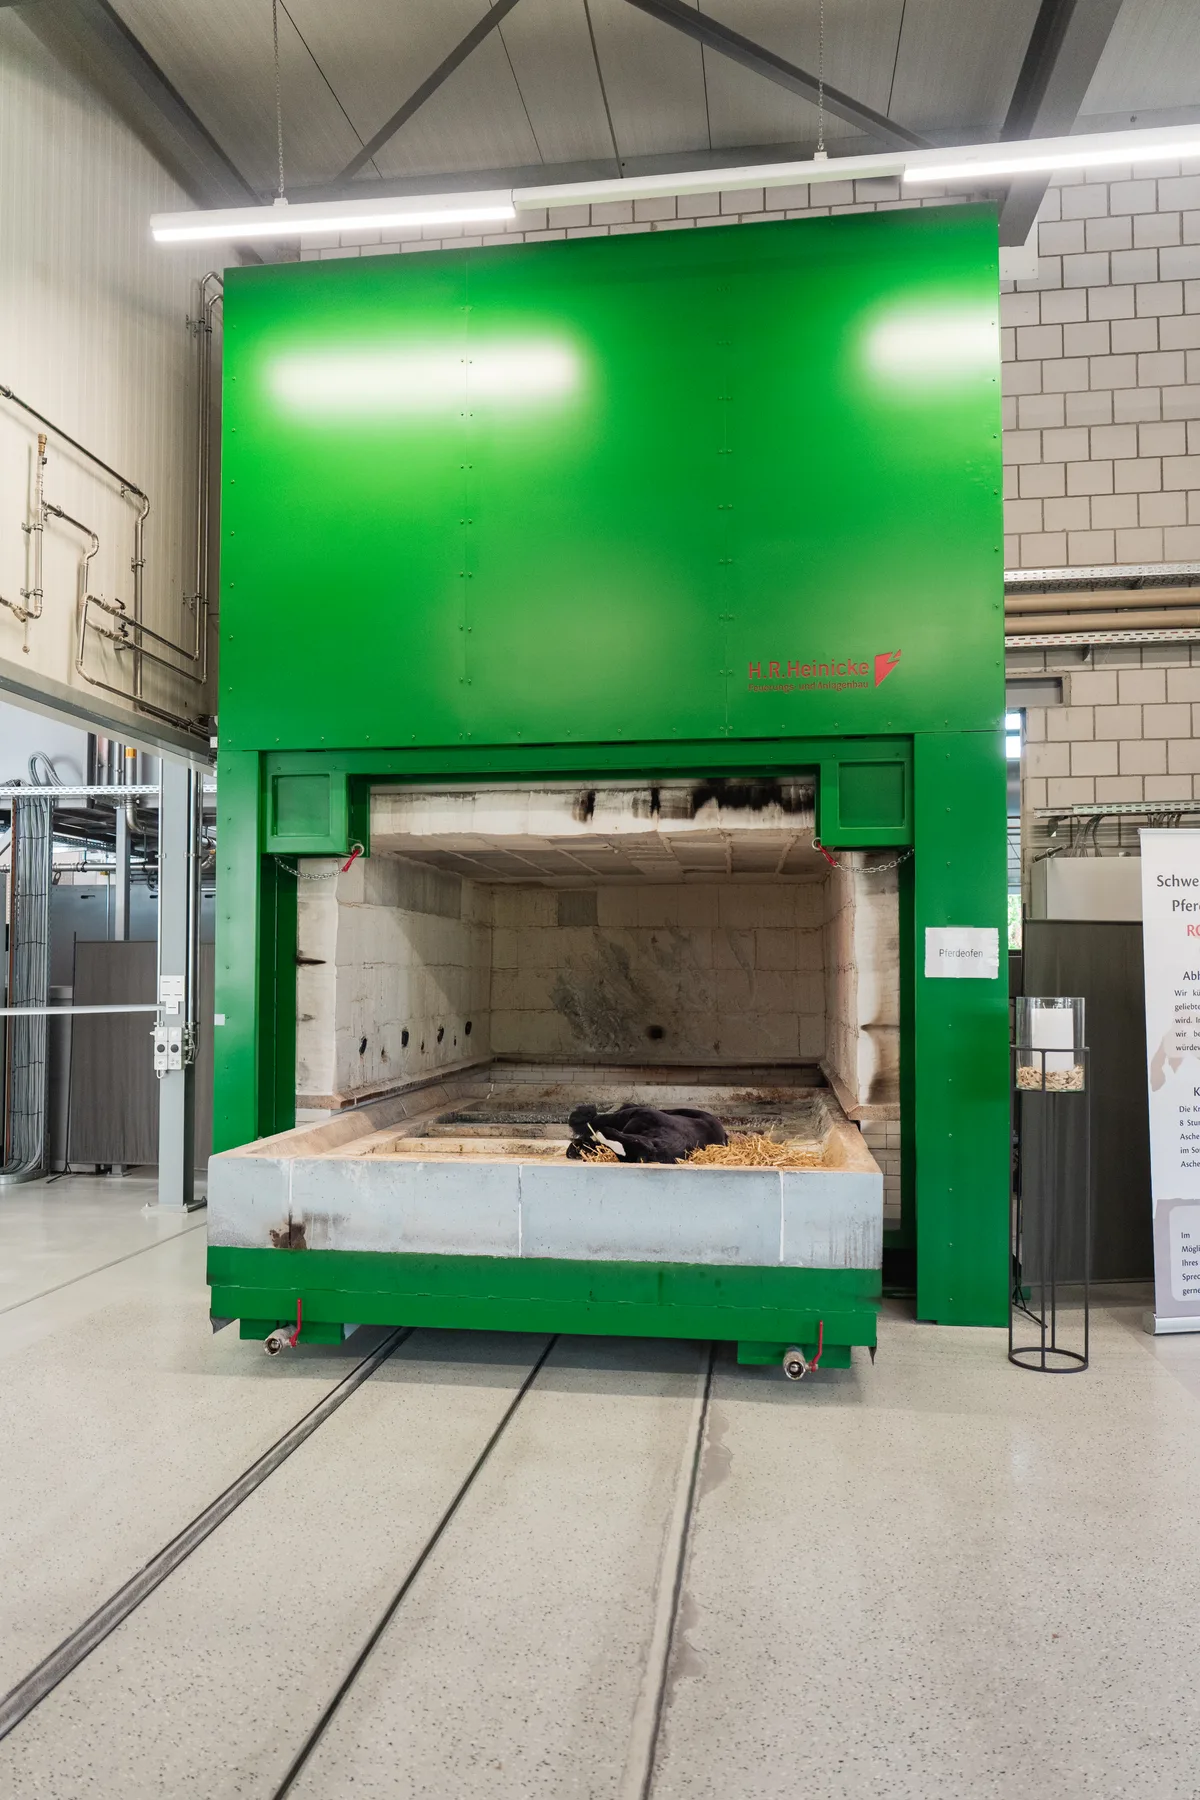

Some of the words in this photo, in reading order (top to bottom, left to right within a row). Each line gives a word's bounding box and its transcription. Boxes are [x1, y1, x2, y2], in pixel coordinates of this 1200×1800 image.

[799, 682, 816, 691] und
[817, 680, 868, 691] Anlagenbau
[1156, 874, 1199, 887] Schwe
[1172, 898, 1200, 912] Pfer
[939, 948, 983, 957] Pferdeofen
[1174, 989, 1187, 997] Wir
[1175, 1016, 1193, 1024] wird.
[1181, 1259, 1198, 1267] Ihres
